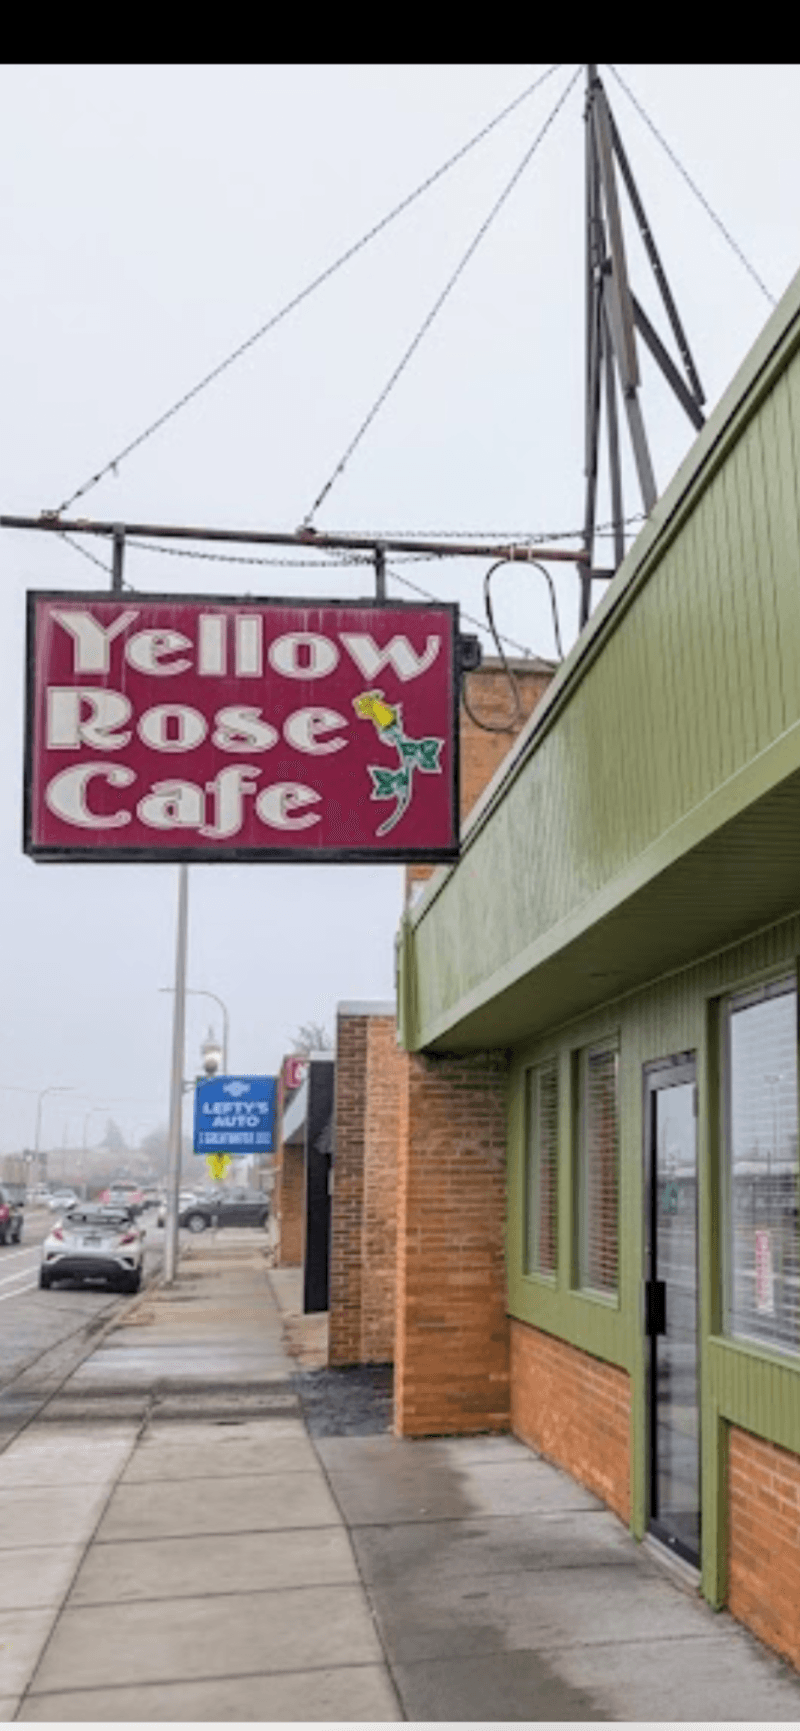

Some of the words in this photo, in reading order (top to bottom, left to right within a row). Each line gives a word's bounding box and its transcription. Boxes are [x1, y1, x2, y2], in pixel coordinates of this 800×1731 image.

[49, 609, 441, 682] Yellow
[46, 686, 349, 756] Rose
[46, 761, 323, 839] Cafe
[202, 1101, 269, 1115] LEFTY'S
[211, 1115, 261, 1128] AUTO
